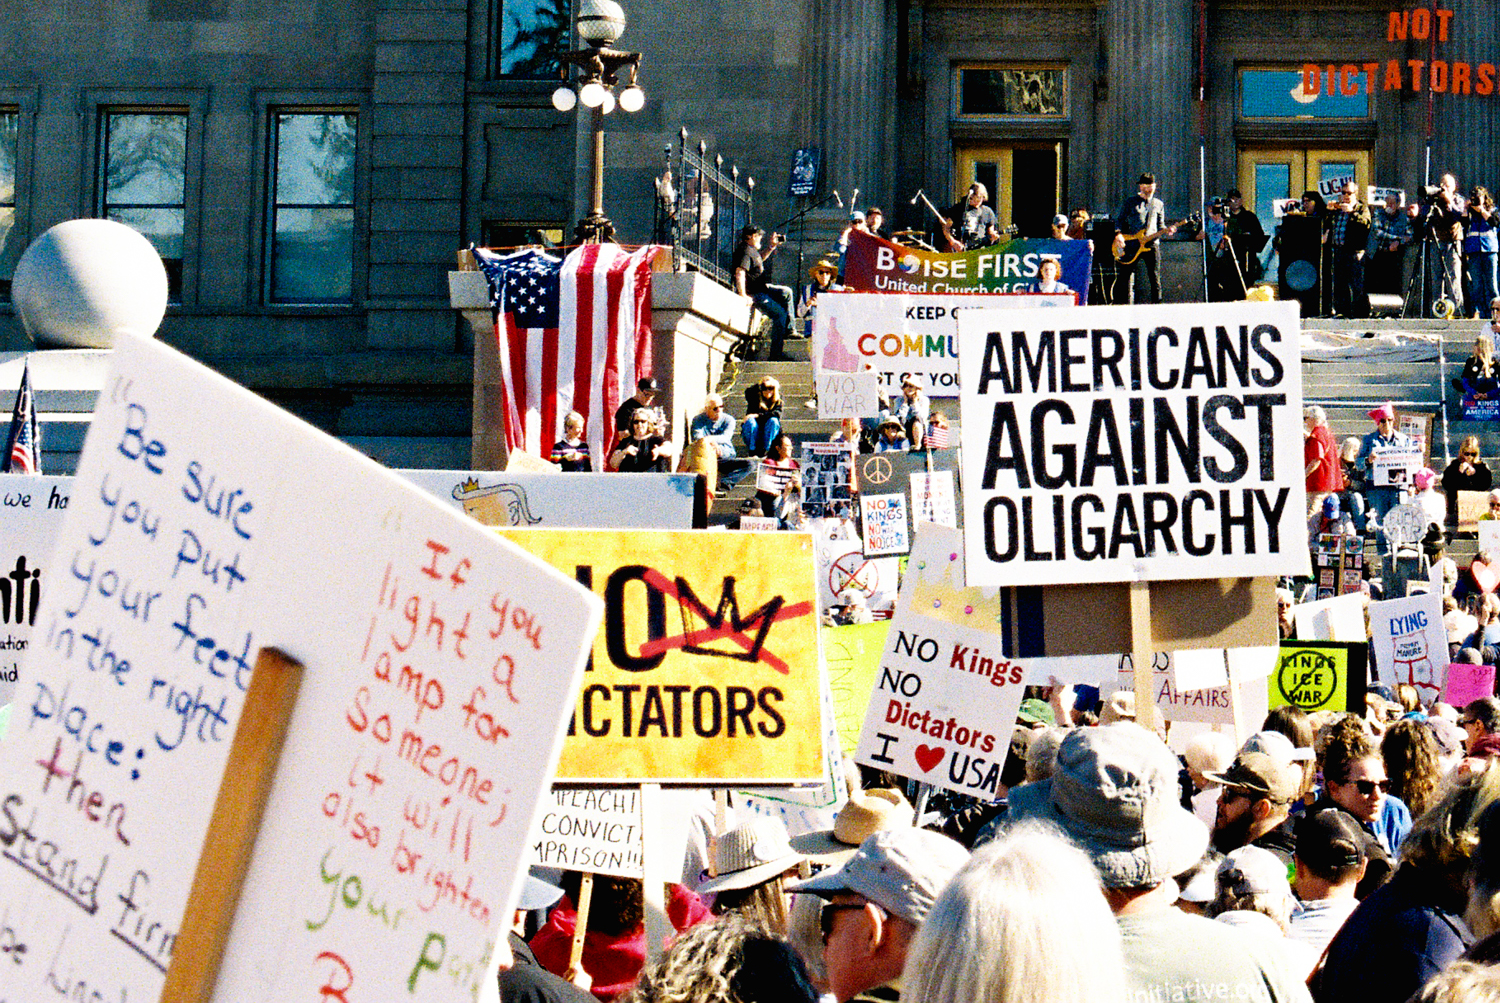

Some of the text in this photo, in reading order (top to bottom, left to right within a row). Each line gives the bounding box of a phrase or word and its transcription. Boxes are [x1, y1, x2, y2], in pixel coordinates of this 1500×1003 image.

[1387, 8, 1454, 42] NOT
[905, 306, 946, 320] KEEP
[977, 323, 1285, 396] AMERICANS
[824, 395, 867, 415] WAR
[825, 376, 856, 395] NO
[981, 392, 1287, 491] AGAINST
[4, 491, 32, 508] we
[866, 499, 887, 511] NO
[867, 508, 903, 522] KINGS
[89, 473, 247, 594] you put
[868, 523, 881, 536] NO
[869, 537, 882, 550] NO
[983, 487, 1290, 563] OLIGARCHY
[65, 550, 252, 692] your feet
[488, 591, 542, 651] you
[1390, 610, 1428, 636] LYING
[893, 631, 1023, 687] NO Kings
[1281, 655, 1336, 669] KINGS
[1293, 673, 1323, 686] ICE
[879, 666, 921, 697] NO
[1156, 678, 1230, 708] AFFAIRS
[1288, 690, 1322, 703] WAR
[149, 675, 228, 752] right
[462, 686, 510, 745] for
[884, 699, 996, 753] Dictators
[870, 732, 1000, 794] I USA
[35, 737, 131, 847] then
[322, 792, 381, 849] also
[403, 794, 474, 863] will
[306, 846, 405, 932] your
